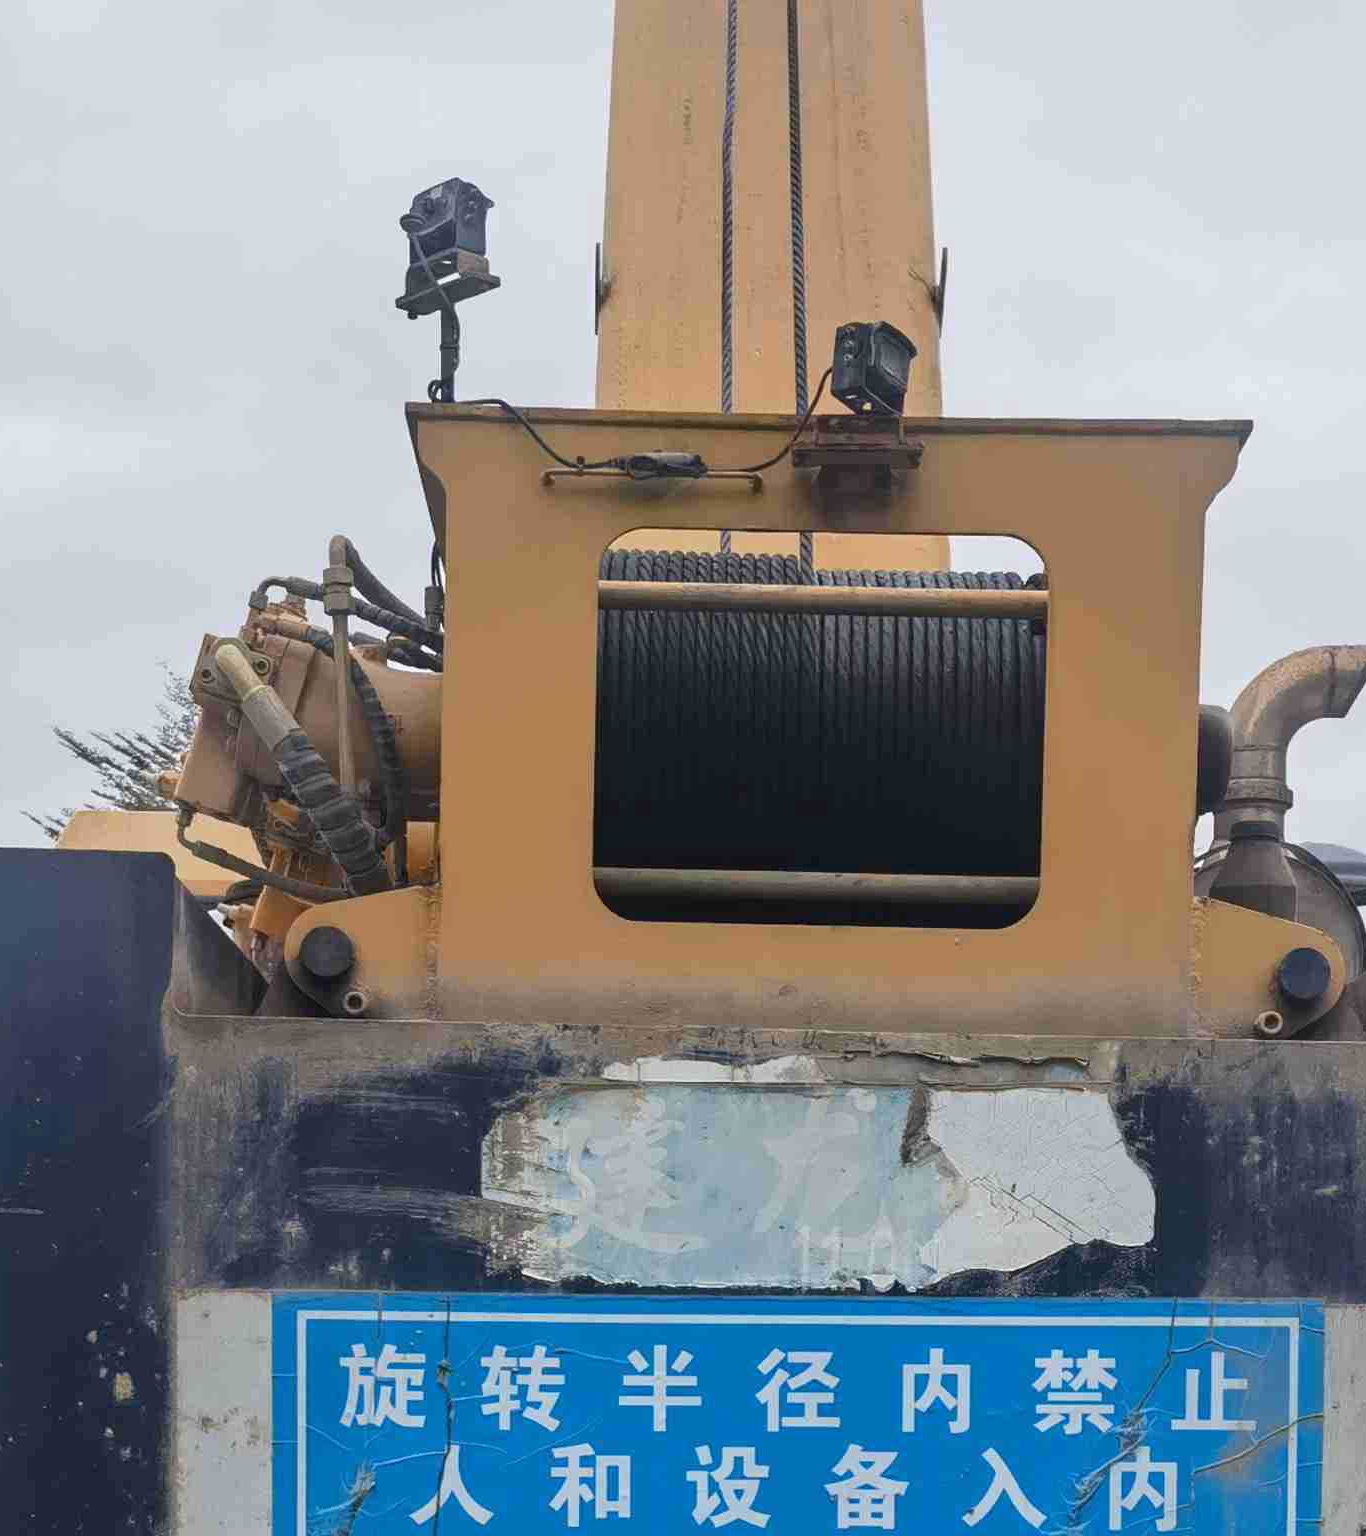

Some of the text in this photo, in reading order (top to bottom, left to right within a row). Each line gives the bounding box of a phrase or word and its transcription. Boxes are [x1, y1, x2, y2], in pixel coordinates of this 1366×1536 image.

[338, 1343, 1257, 1434] 旋转半径内禁止
[409, 1443, 1178, 1532] 人和设备入内
